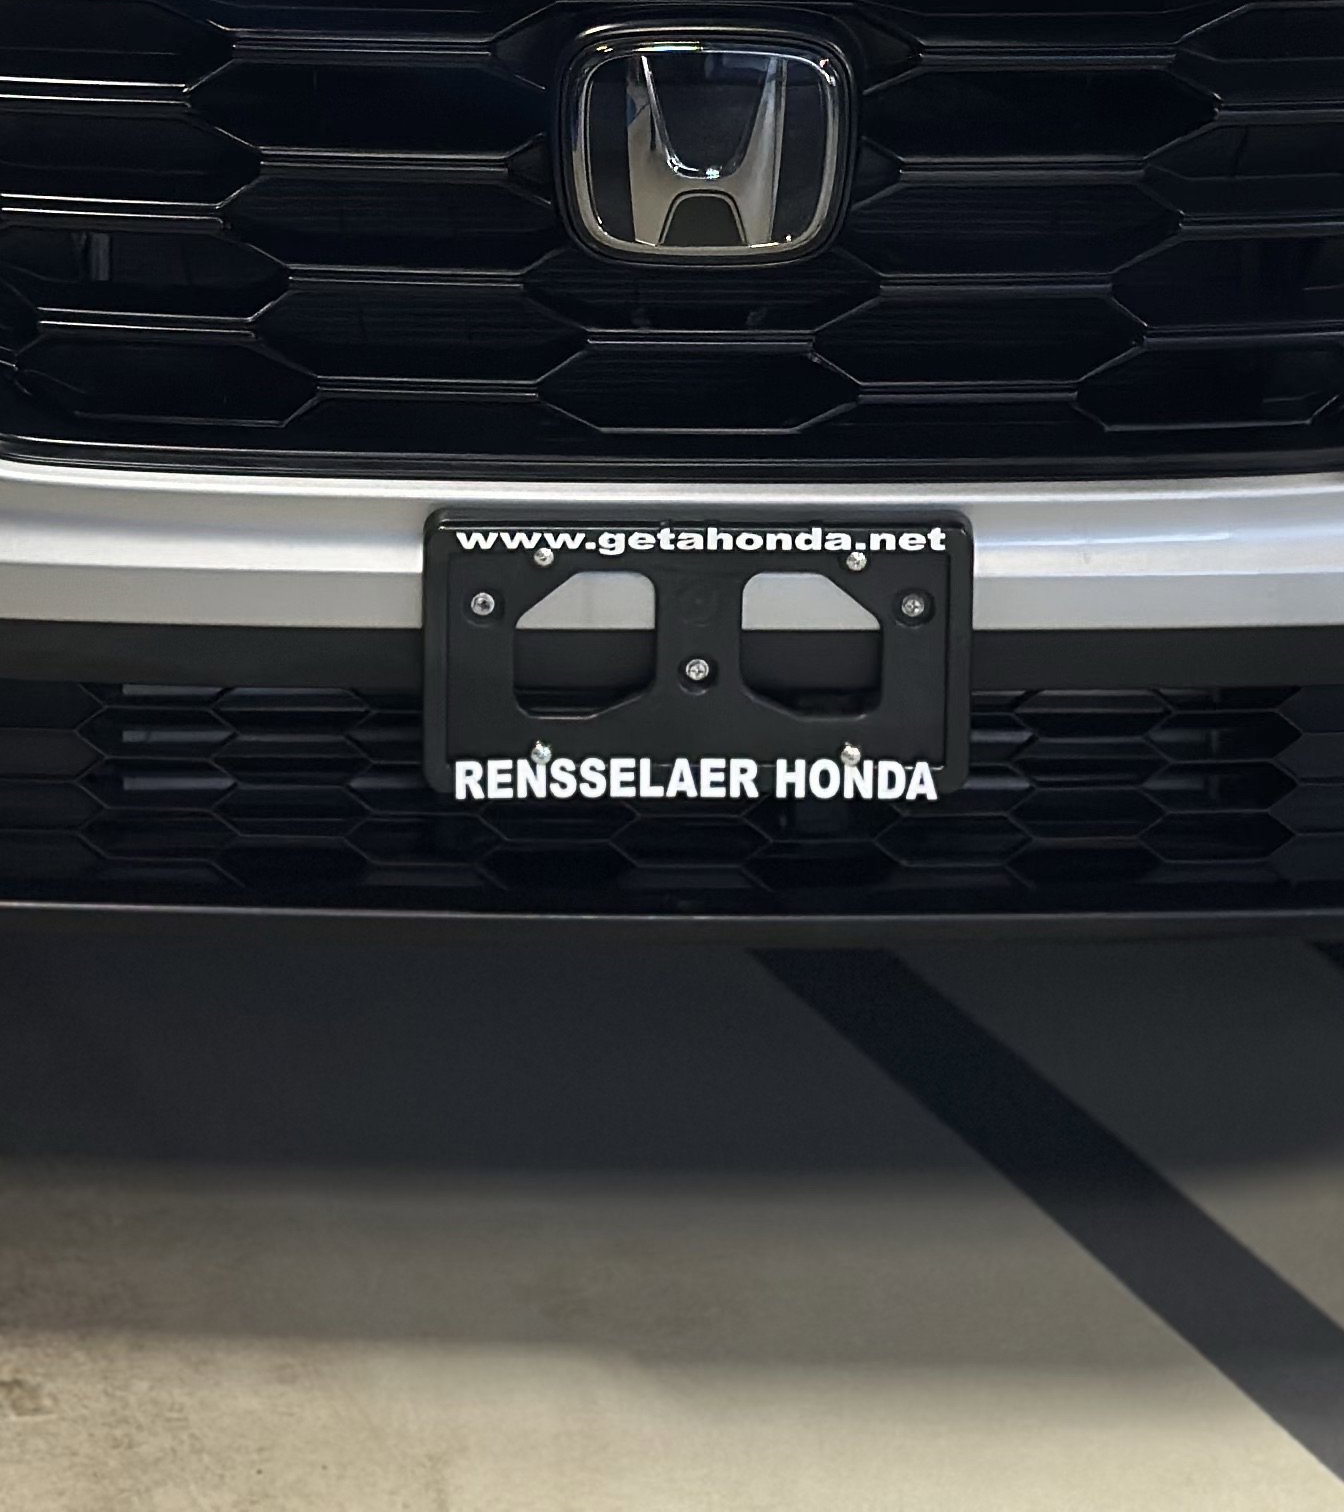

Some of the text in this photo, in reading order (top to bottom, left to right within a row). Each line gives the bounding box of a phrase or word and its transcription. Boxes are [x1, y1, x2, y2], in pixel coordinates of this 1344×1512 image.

[456, 527, 946, 556] www.getahonda.net
[455, 758, 938, 800] RENSSELAER HONDA
